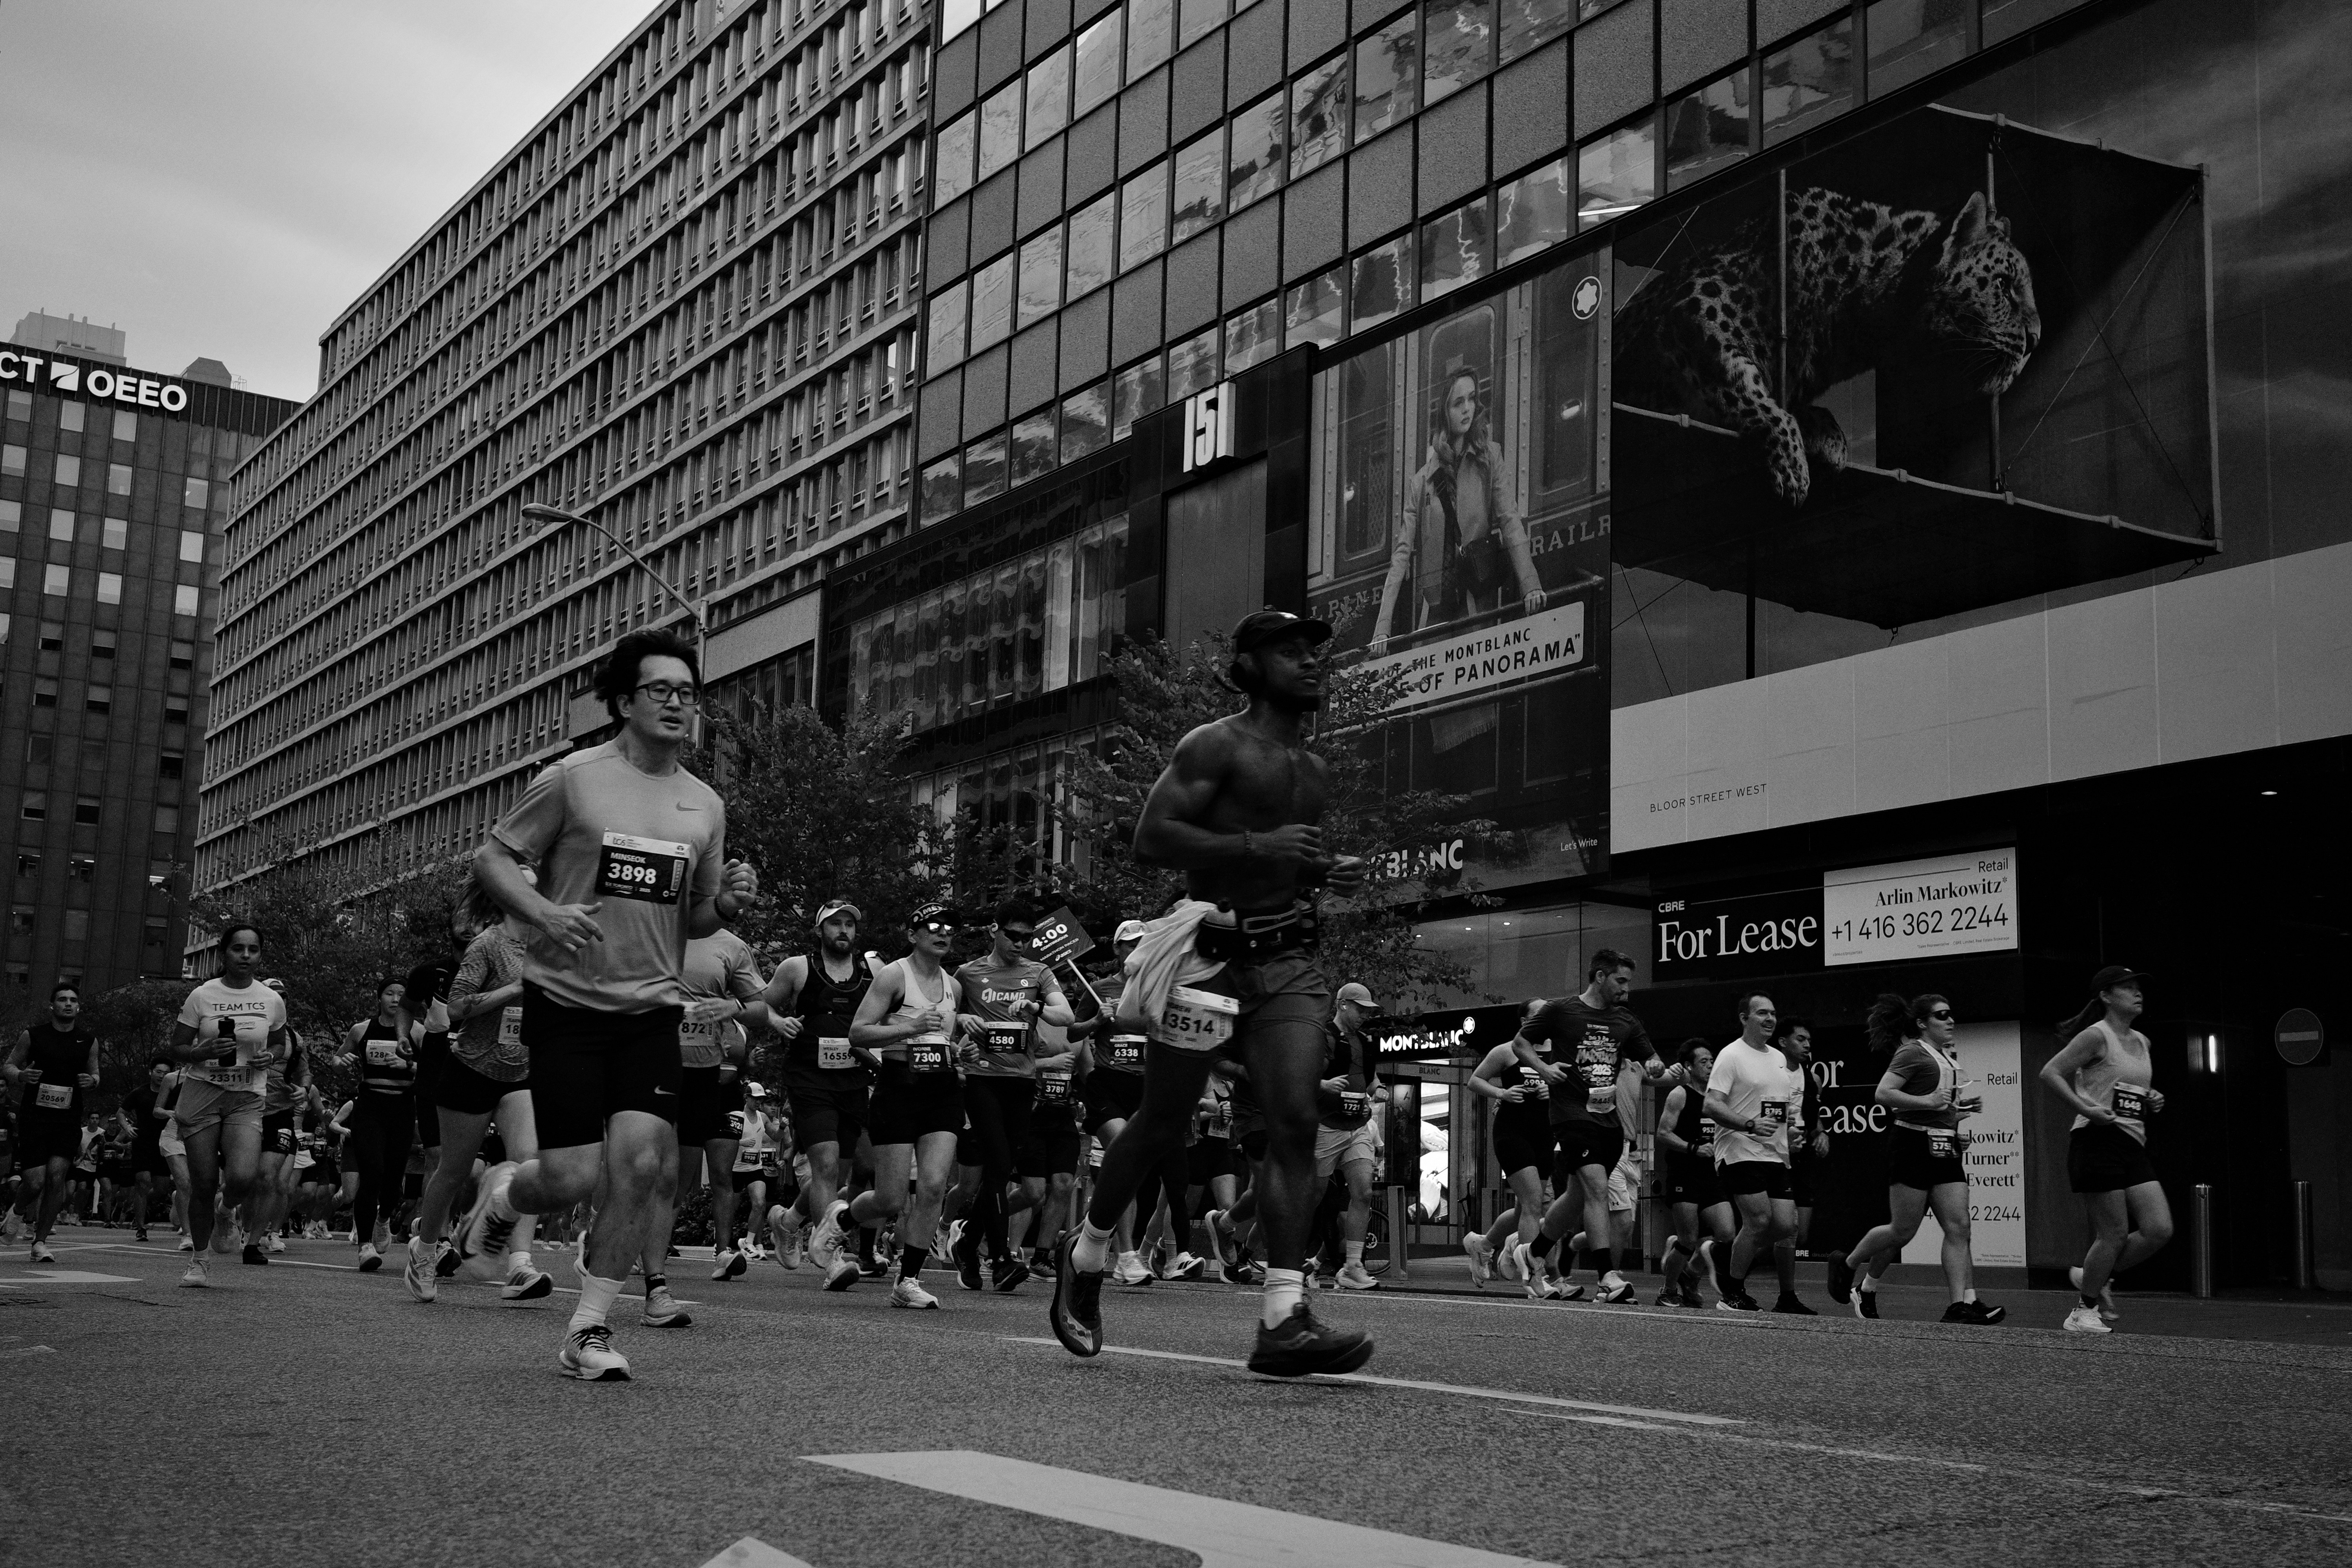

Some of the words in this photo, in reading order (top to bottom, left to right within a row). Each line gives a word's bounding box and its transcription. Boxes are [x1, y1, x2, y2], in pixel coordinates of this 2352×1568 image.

[87, 370, 187, 411] OEEO
[1183, 381, 1236, 473] 151
[1445, 628, 1530, 663] MONTBLANC
[1419, 672, 1444, 693] OF
[1650, 799, 1686, 812] BLOOR
[1690, 790, 1732, 805] STREET
[1736, 784, 1767, 797] WEST
[1561, 840, 1577, 851] Let's
[1578, 838, 1598, 848] Write
[1374, 839, 1463, 878] BLANC
[1978, 857, 2009, 873] Retail
[608, 863, 657, 884] 3898
[1875, 888, 1913, 907] Arlin
[1658, 900, 1685, 913] CBRE
[1034, 917, 1055, 929] TORONTO
[1832, 920, 1851, 942] +1
[1858, 915, 1895, 940] 416
[1902, 910, 1943, 936] 362
[1951, 903, 2009, 932] 2244
[1032, 924, 1067, 948] 4:00
[1040, 934, 1069, 951] CONTINUOUS
[1658, 921, 1712, 962] For
[1716, 915, 1818, 956] Lease
[1040, 946, 1065, 961] MARATHON
[506, 1024, 518, 1034] 18
[682, 1022, 706, 1033] 872
[989, 1036, 1015, 1045] 4580
[913, 1052, 941, 1063] 7300
[1114, 1048, 1138, 1057] 6338
[210, 1074, 241, 1082] 23311
[1419, 1067, 1440, 1075] BLANC
[1809, 1058, 1844, 1088] or
[1987, 1072, 2018, 1085] Retail
[1045, 1085, 1065, 1093] 3789
[40, 1094, 64, 1102] 20569
[1818, 1104, 1887, 1134] ease
[1984, 1206, 2021, 1221] 2244
